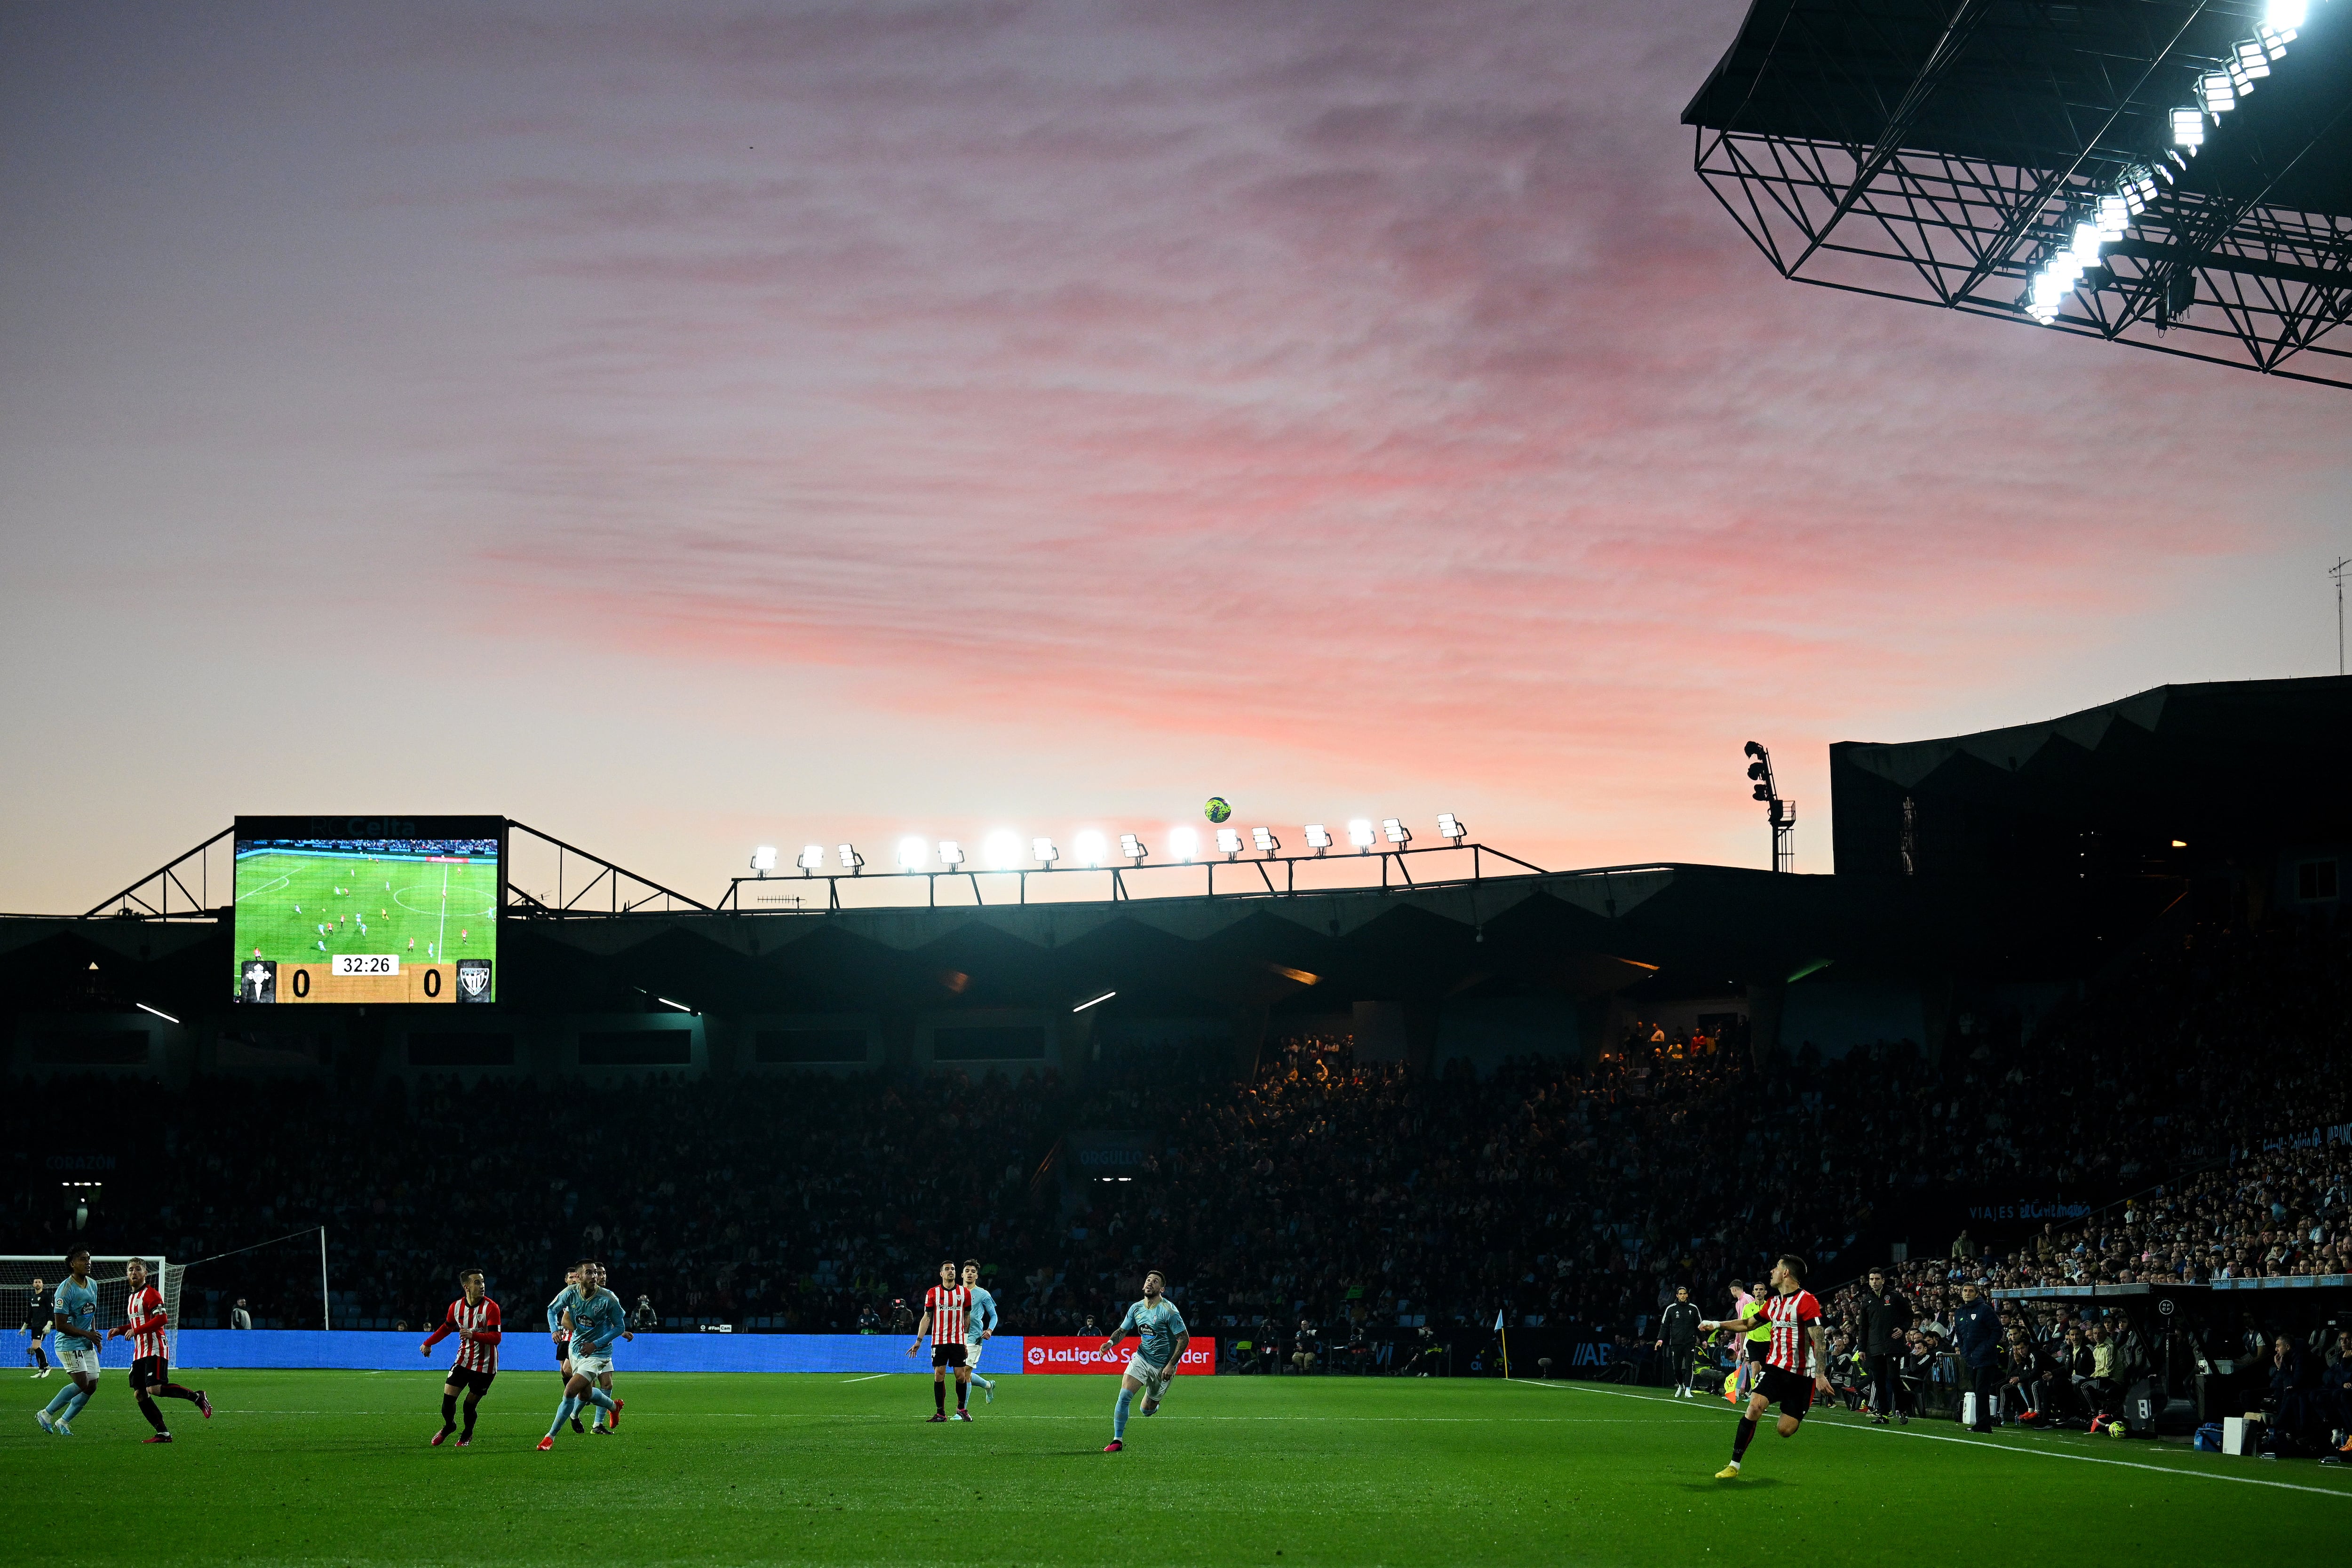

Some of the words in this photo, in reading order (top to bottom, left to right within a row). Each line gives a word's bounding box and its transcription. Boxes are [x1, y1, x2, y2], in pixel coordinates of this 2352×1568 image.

[344, 958, 389, 972] 32:26
[293, 969, 310, 997] 0
[424, 969, 440, 997] 0
[46, 1154, 116, 1170] CORAZÓN
[1969, 1205, 2014, 1222] VIAJES
[72, 1350, 83, 1359] 14
[1048, 1347, 1101, 1365] LaLiga
